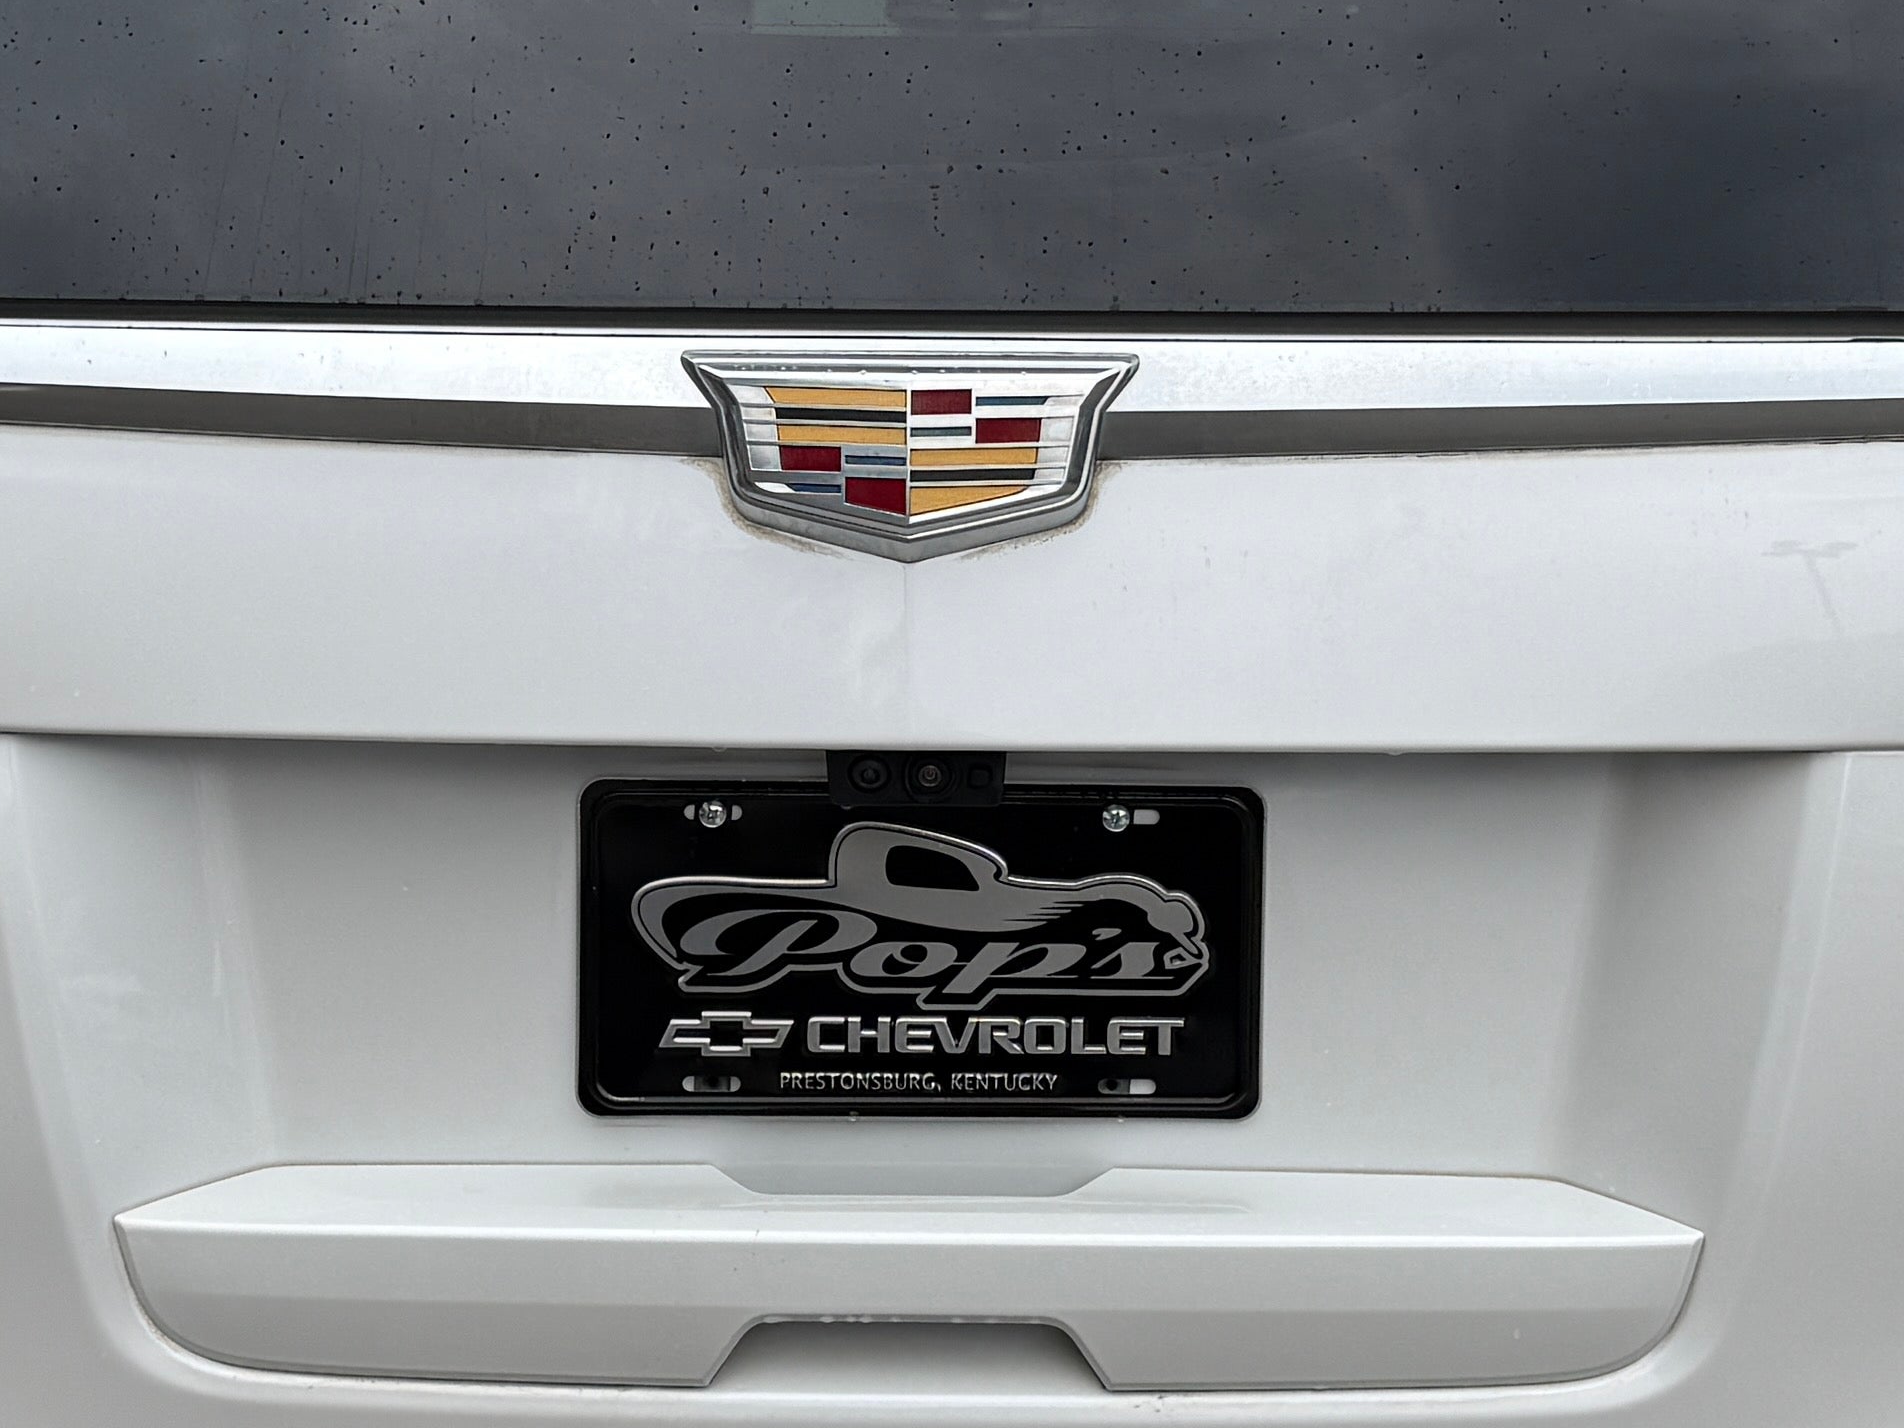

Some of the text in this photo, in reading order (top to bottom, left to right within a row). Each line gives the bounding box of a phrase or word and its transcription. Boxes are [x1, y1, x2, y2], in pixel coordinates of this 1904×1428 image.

[680, 908, 1164, 996] Pop's
[807, 1015, 1186, 1057] CHEVROLET
[779, 1071, 1059, 1093] PRESTONSBURG, KENTUCKY
